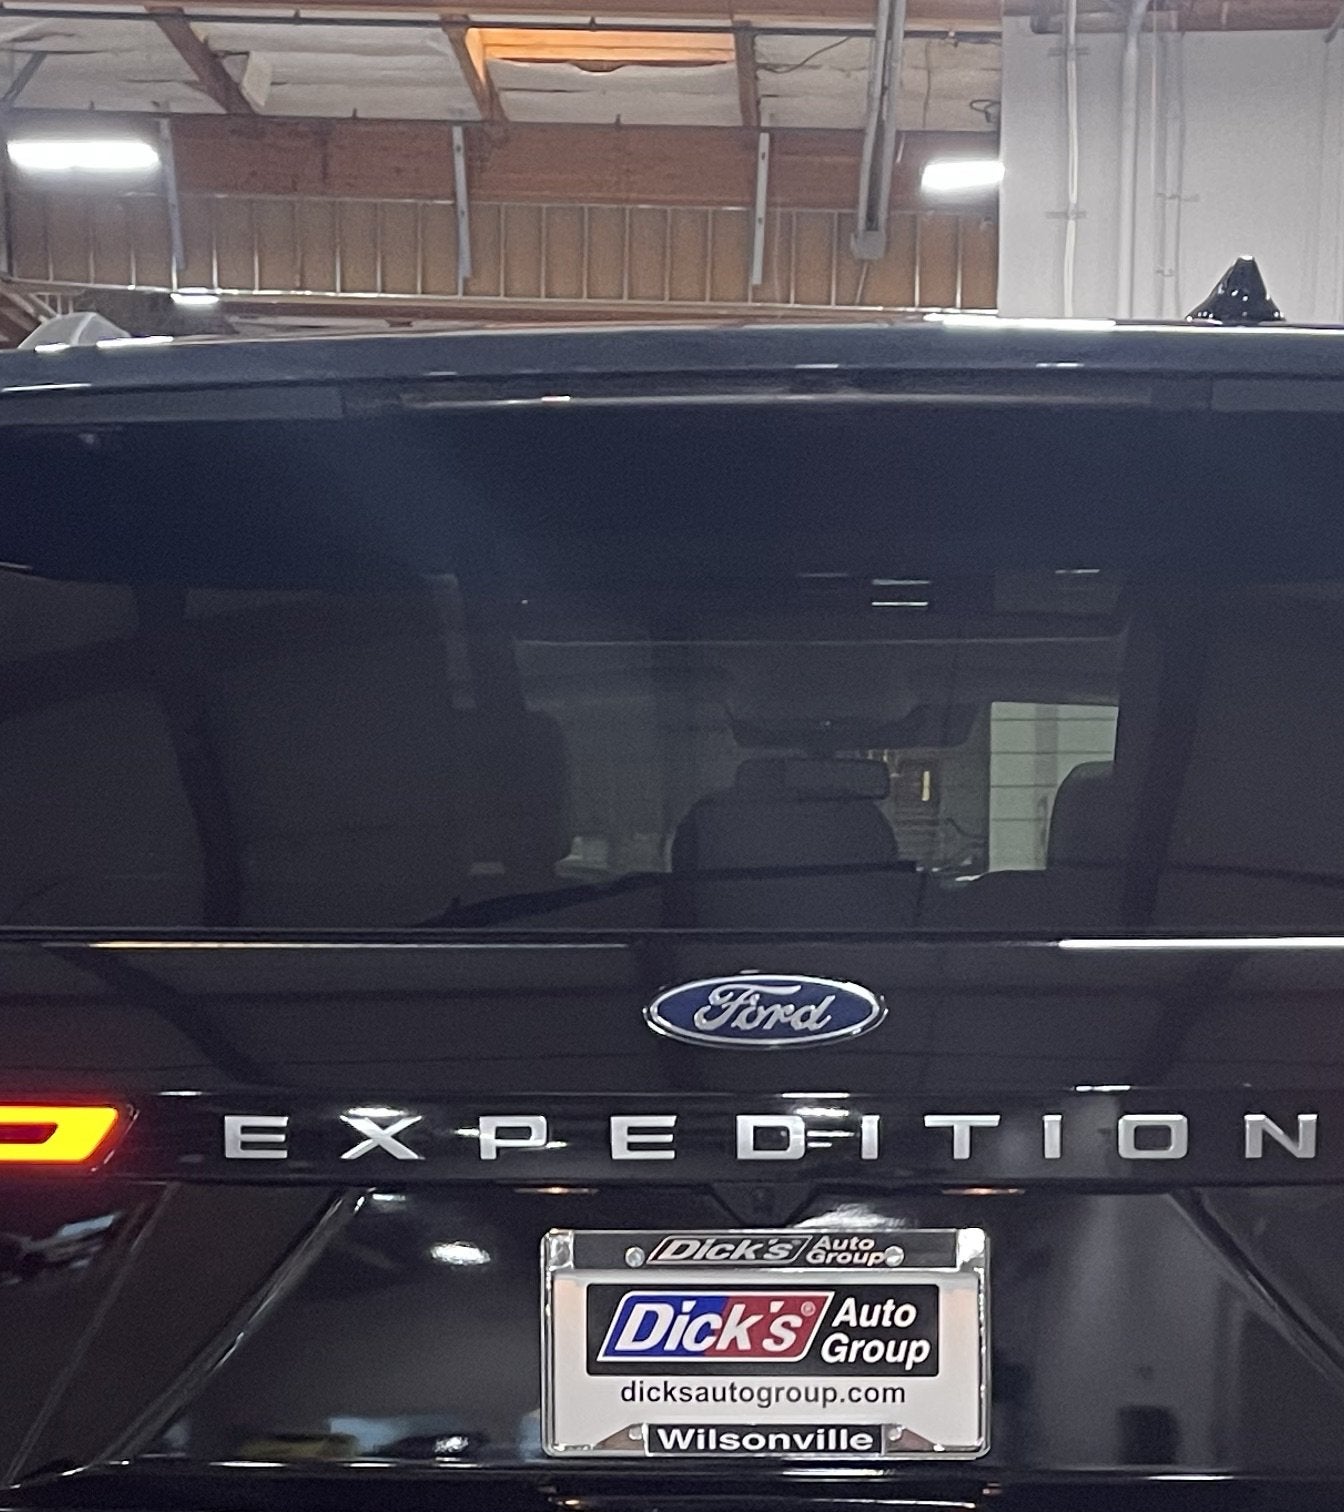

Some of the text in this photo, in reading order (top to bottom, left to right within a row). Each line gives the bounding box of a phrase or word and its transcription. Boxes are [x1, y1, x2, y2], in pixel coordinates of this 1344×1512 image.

[694, 984, 835, 1031] Ford
[223, 1113, 1319, 1162] EXPEDITION
[657, 1235, 875, 1260] Dick's Auto
[806, 1251, 885, 1267] Group
[614, 1297, 917, 1352] Dick's Auto
[821, 1332, 931, 1371] Group
[620, 1380, 906, 1408] dicksautogroup.com
[657, 1427, 874, 1452] Wilsonville
